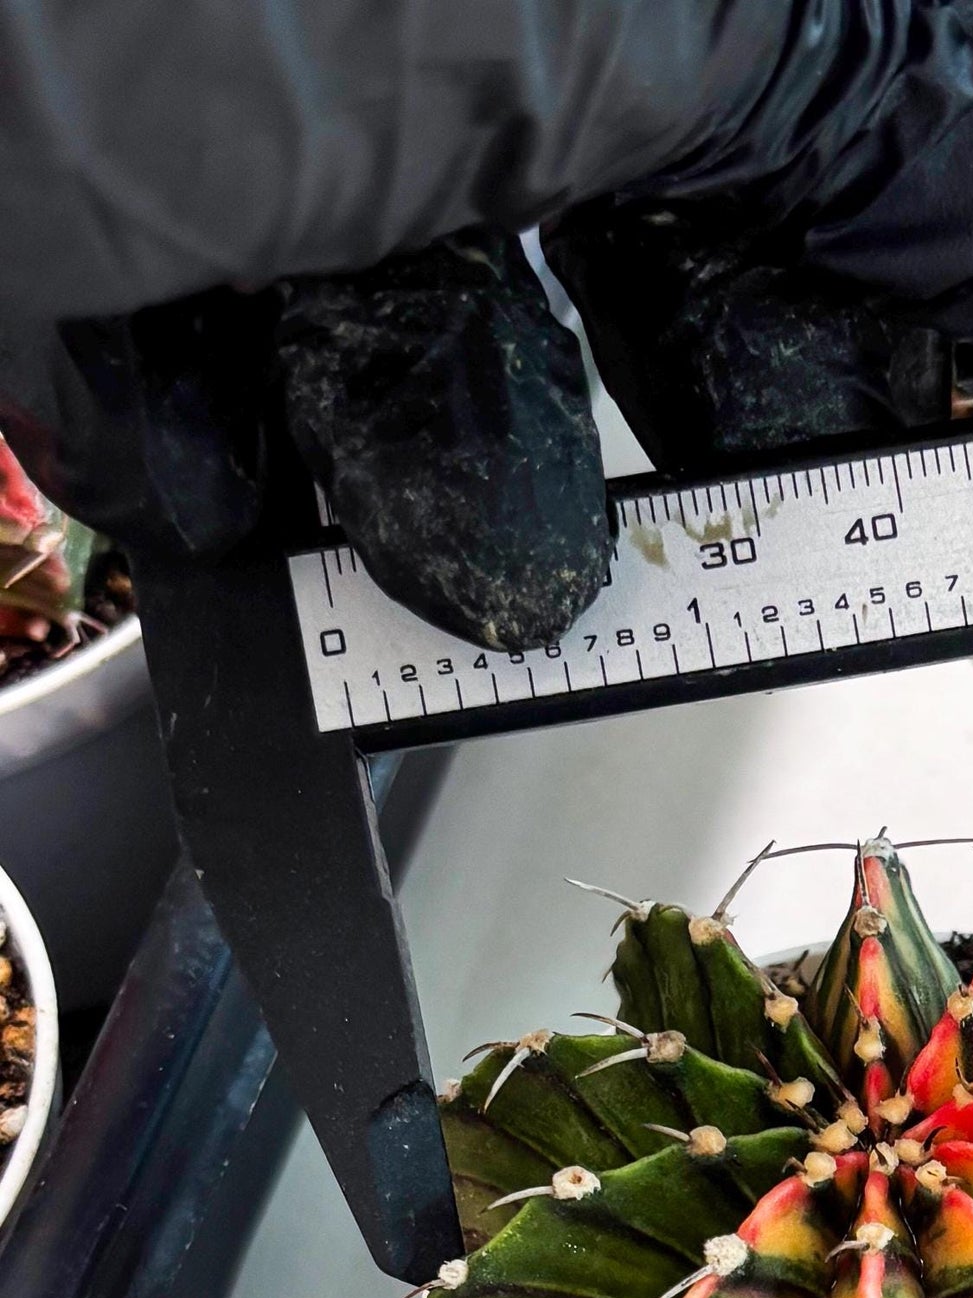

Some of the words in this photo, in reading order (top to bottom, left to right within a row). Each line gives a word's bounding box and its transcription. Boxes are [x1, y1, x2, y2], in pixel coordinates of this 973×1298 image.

[699, 536, 757, 570] 30
[843, 513, 898, 546] 40
[319, 628, 347, 657] 0
[371, 670, 381, 687] 1
[399, 663, 419, 683] 2
[436, 658, 455, 676] 3
[472, 652, 489, 670] 4
[583, 634, 598, 653] 7
[615, 628, 635, 647] 8
[652, 622, 672, 642] 9
[686, 597, 701, 624] 1
[732, 610, 742, 628] 1
[761, 605, 780, 623] 2
[797, 598, 816, 616] 3
[834, 592, 850, 612] 4
[868, 586, 887, 605] 5
[904, 580, 923, 599] 6
[944, 574, 960, 593] 7
